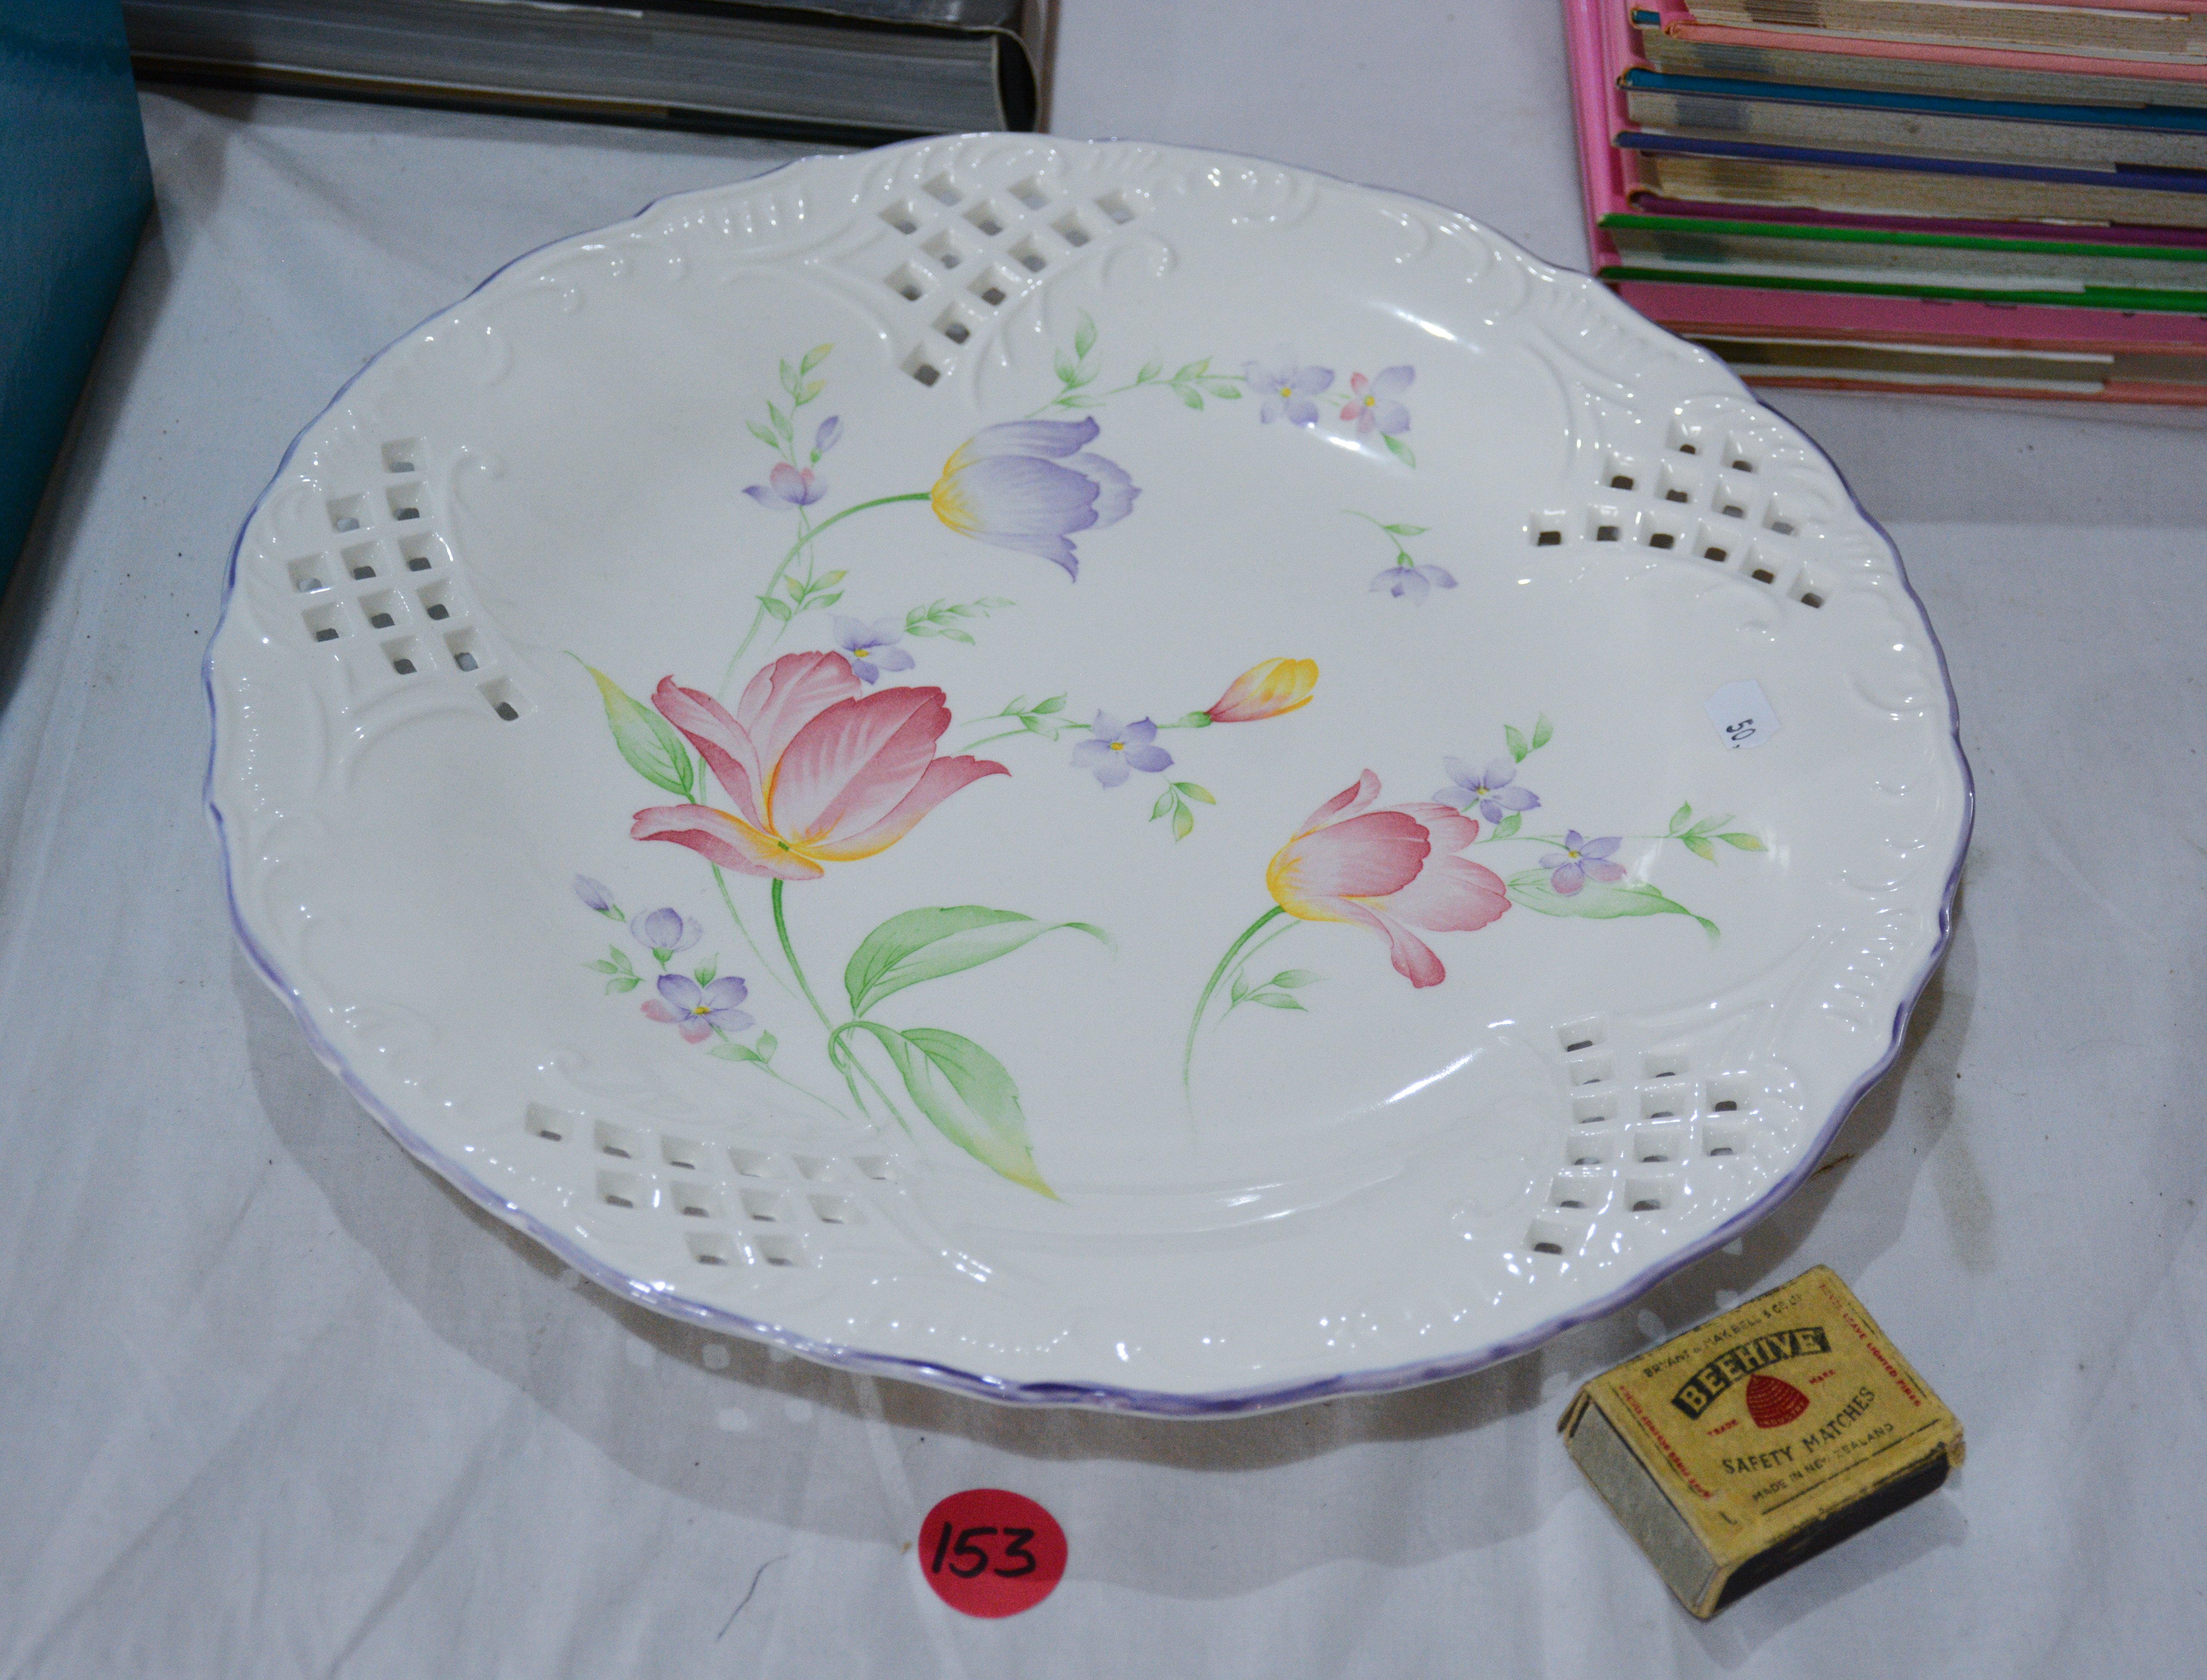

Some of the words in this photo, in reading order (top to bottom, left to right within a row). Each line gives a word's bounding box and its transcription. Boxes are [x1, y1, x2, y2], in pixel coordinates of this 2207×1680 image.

[1679, 1329, 1826, 1416] BEEHIVE
[1843, 1313, 1867, 1340] LEAVE
[1867, 1342, 1898, 1378] LIGHTED
[1895, 1379, 1922, 1407] FIRES
[1707, 1419, 1738, 1435] TRADE
[1809, 1369, 1836, 1384] MARK
[1722, 1446, 1794, 1474] SAFETY
[1802, 1386, 1875, 1453] MATCHES
[1752, 1478, 1788, 1502] MADE
[1789, 1471, 1804, 1481] IN
[1833, 1423, 1895, 1458] ZEALAND
[931, 1522, 1036, 1579] 153
